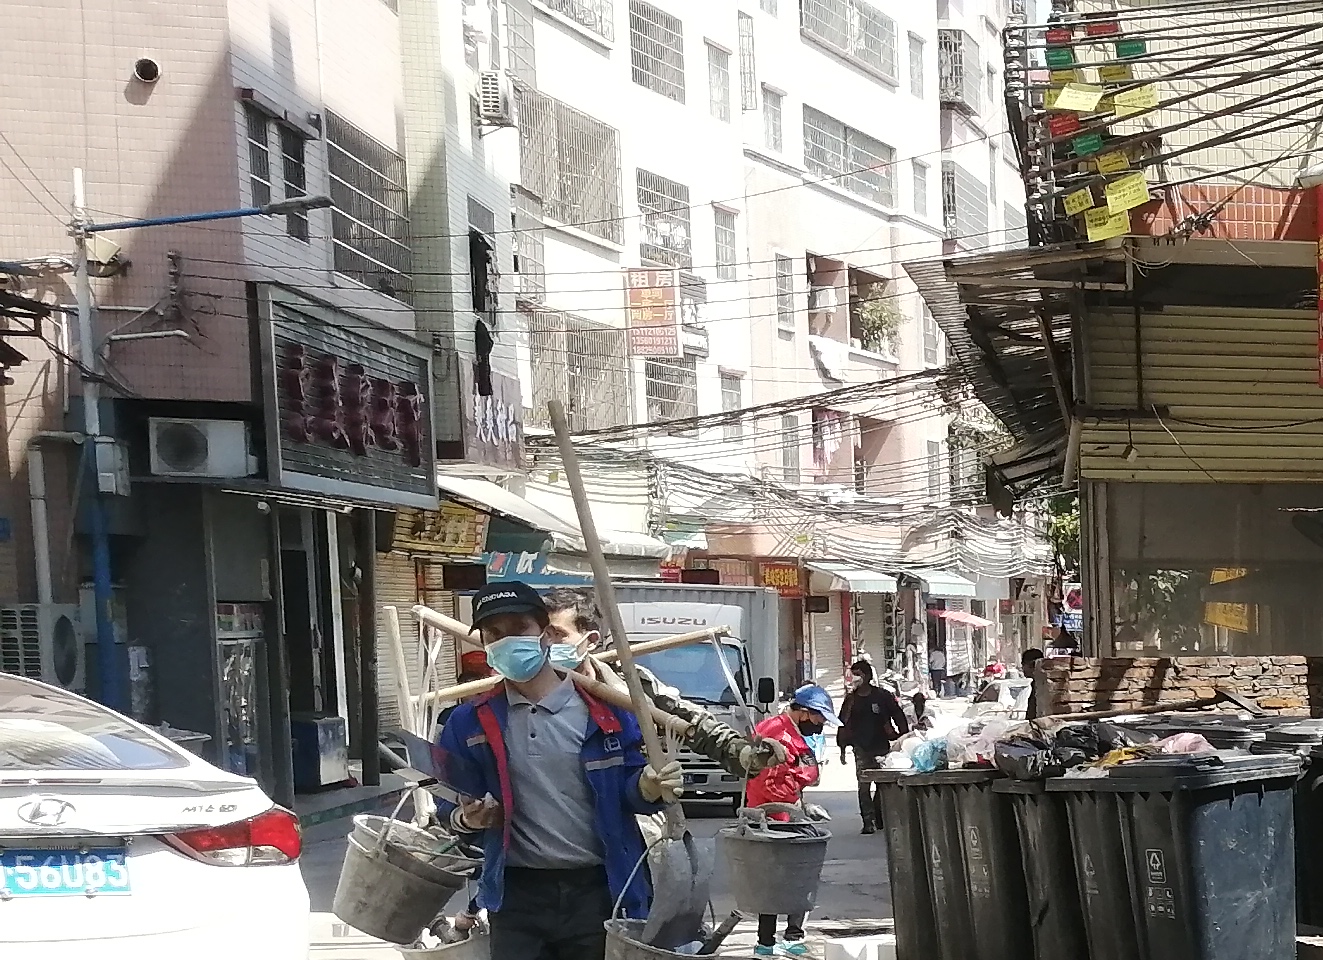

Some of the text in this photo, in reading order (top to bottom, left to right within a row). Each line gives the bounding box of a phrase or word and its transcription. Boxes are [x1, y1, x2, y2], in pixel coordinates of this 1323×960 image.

[631, 271, 673, 287] 租房
[641, 617, 707, 626] ISUZU
[0, 855, 128, 890] 56U83
